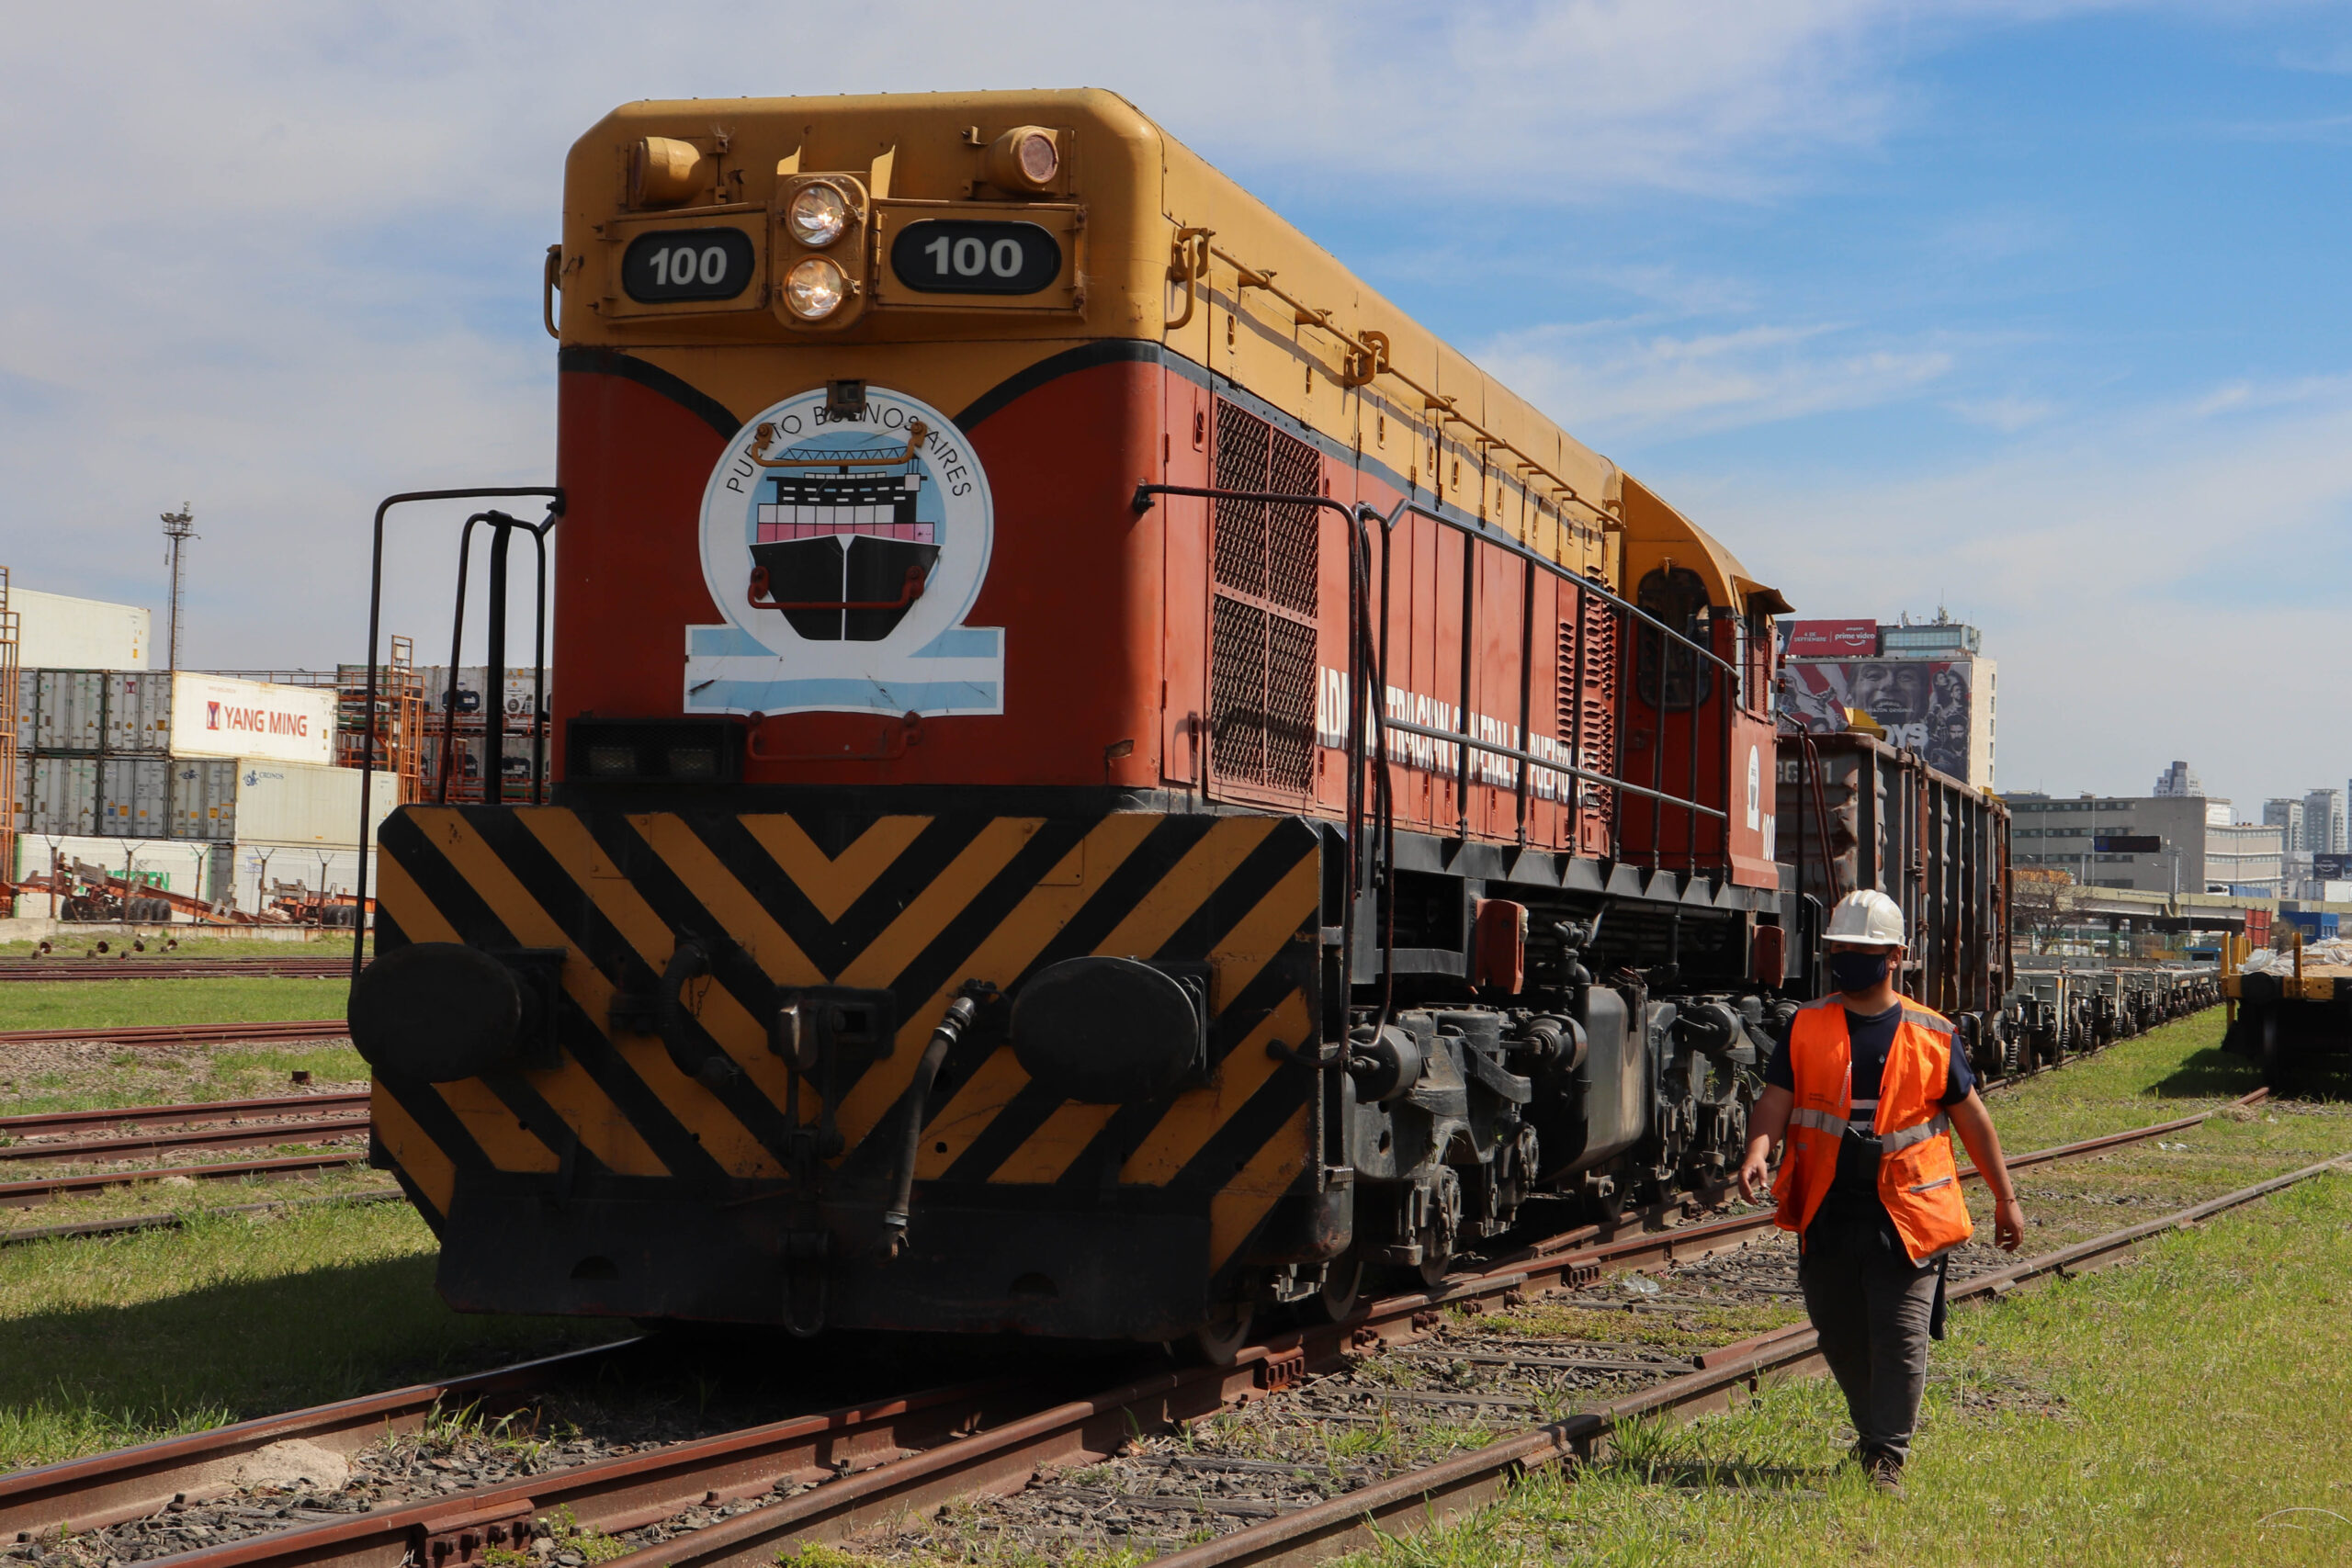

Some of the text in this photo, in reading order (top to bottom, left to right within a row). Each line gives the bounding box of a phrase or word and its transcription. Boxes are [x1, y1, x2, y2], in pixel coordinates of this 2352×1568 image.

[649, 246, 728, 285] 100
[924, 236, 1023, 277] 100
[726, 402, 972, 497] PUETO BNOS AIRES
[1835, 632, 1855, 640] prime
[224, 705, 308, 737] YANG MING
[1452, 705, 1510, 788] GNERAL
[1529, 732, 1571, 805] PUERTO
[1762, 812, 1775, 862] 100
